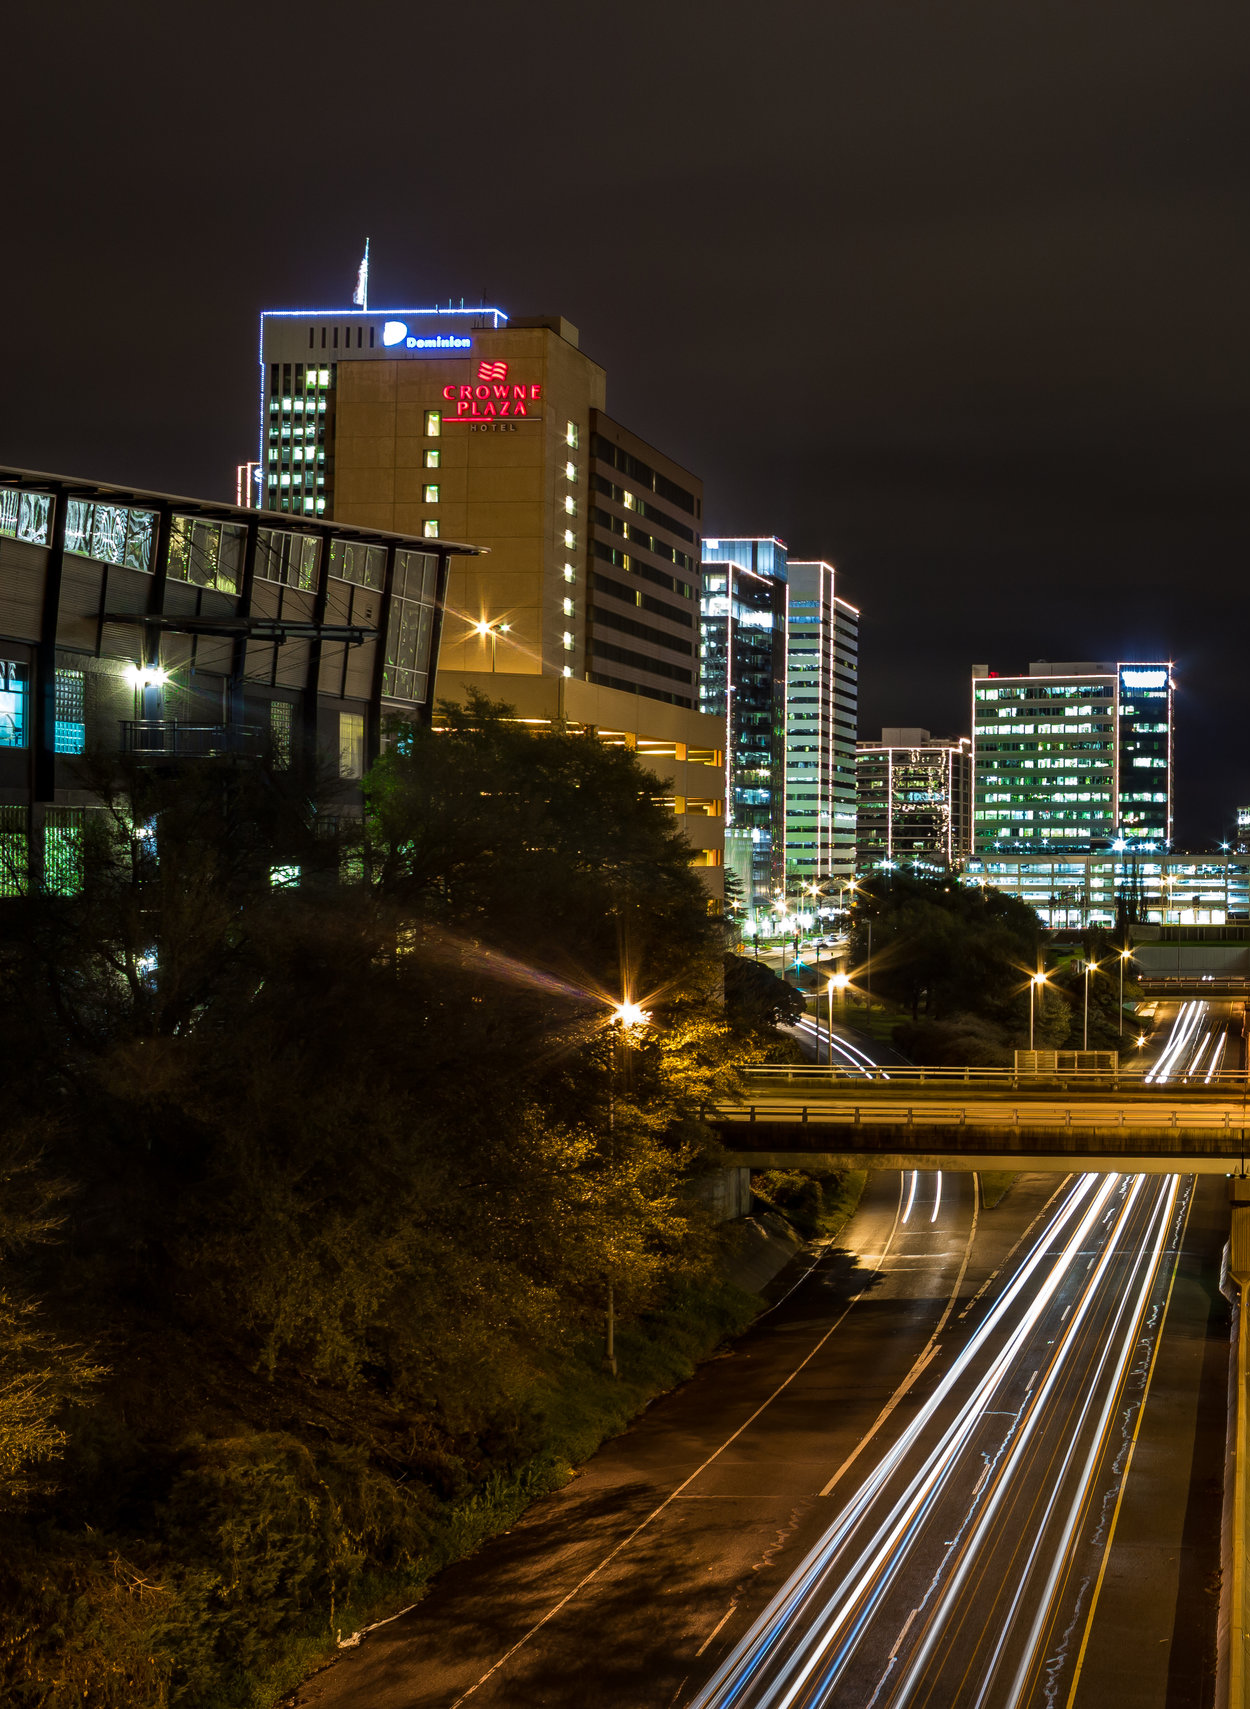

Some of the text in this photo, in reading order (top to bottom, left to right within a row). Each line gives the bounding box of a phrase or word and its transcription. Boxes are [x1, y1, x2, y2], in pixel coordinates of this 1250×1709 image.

[406, 335, 471, 349] Dominion
[442, 385, 542, 400] CROWNE
[457, 401, 527, 416] PLAZA
[470, 424, 517, 432] HOTEL
